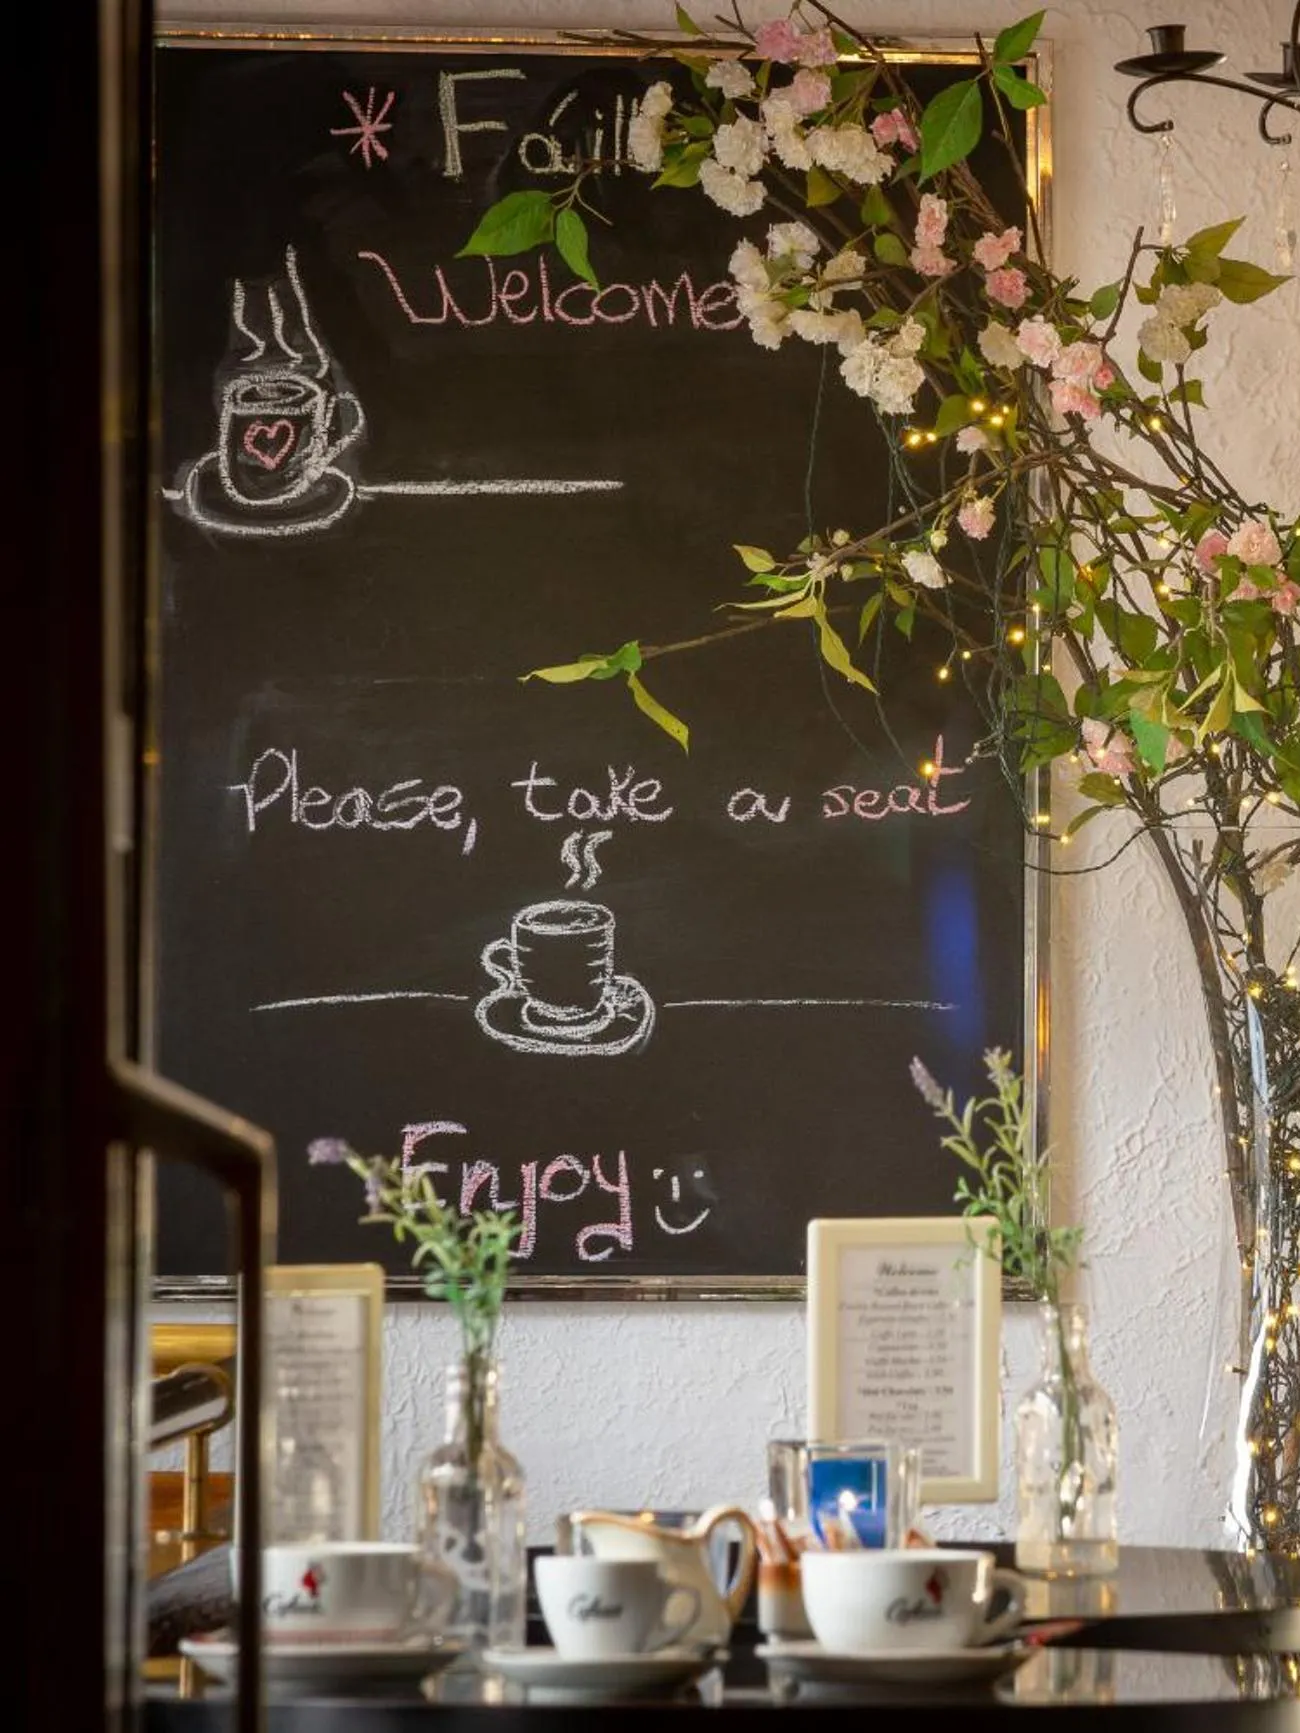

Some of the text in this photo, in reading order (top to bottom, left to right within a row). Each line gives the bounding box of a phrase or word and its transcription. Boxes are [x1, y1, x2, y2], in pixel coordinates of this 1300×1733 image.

[438, 67, 642, 182] Fáil
[357, 250, 746, 331] Welcome
[227, 733, 972, 855] Please, take a seat
[400, 1120, 633, 1261] Enjoy
